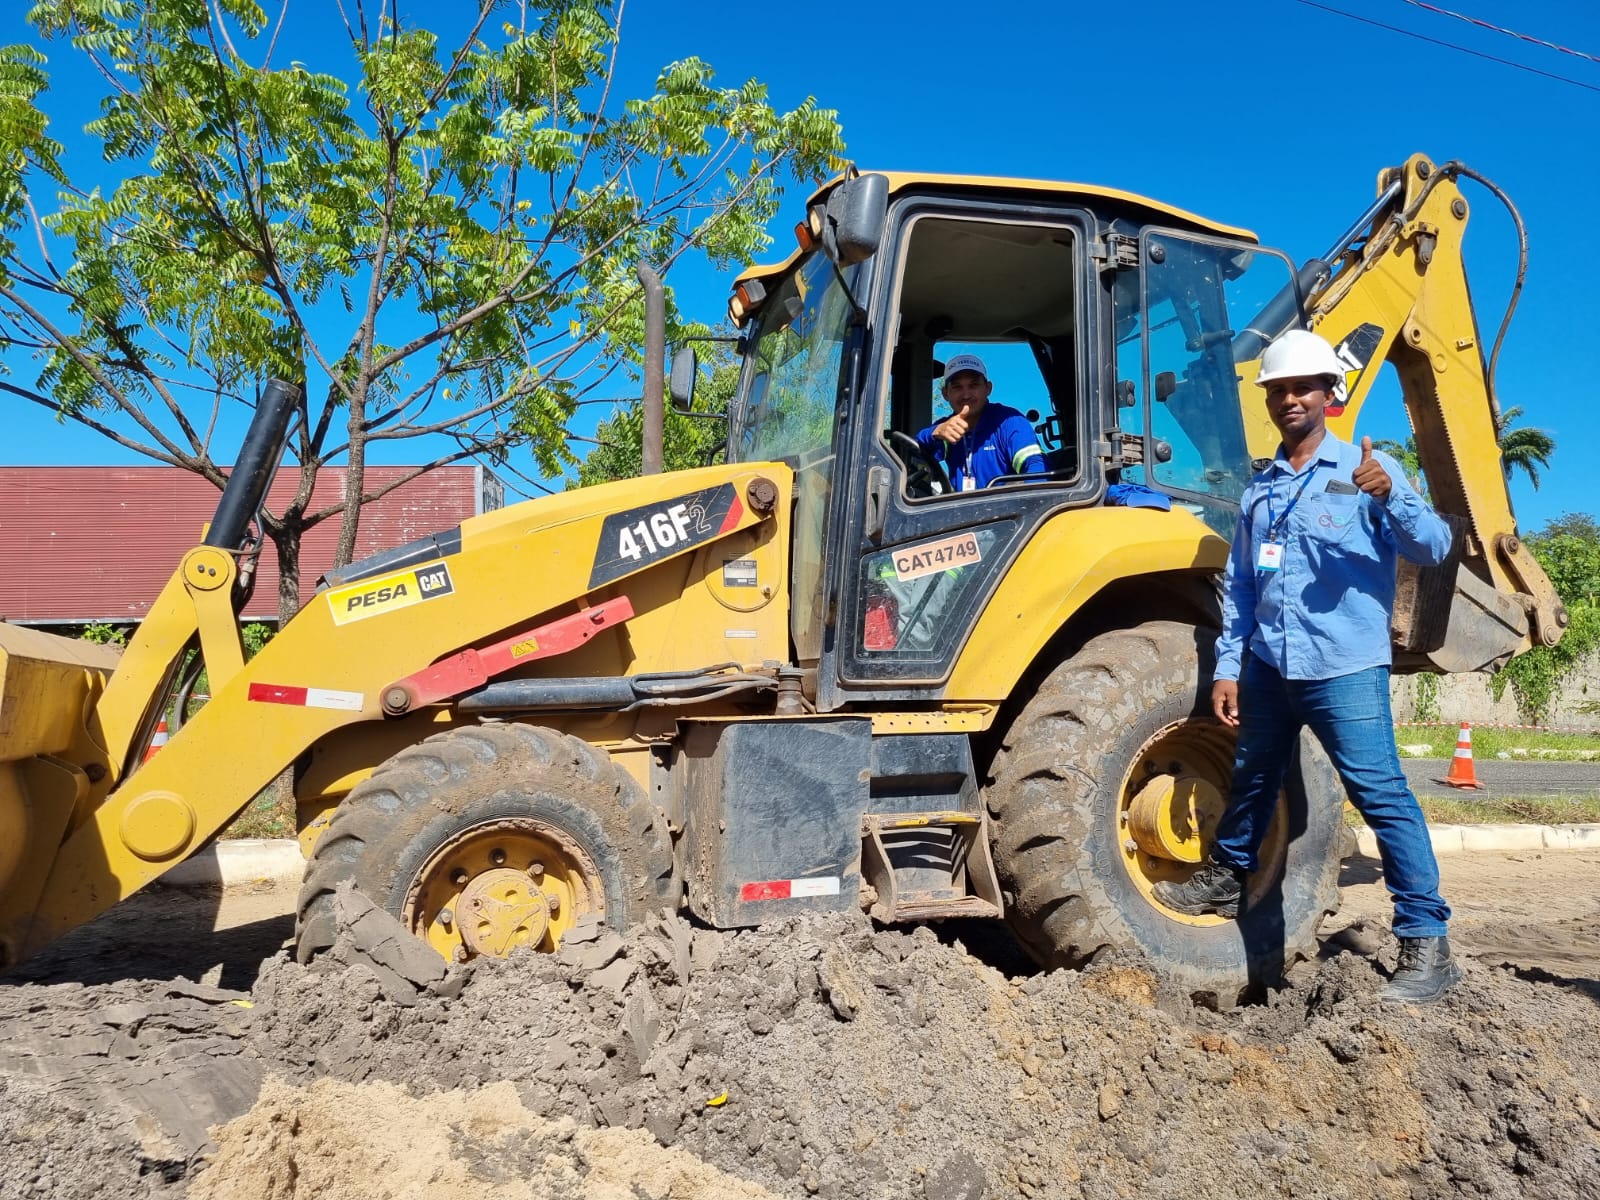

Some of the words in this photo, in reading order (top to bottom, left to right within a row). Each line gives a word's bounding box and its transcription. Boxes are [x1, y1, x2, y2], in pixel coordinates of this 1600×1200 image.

[896, 540, 977, 573] CAT4749
[347, 583, 408, 612] PESA
[419, 571, 447, 592] CAT
